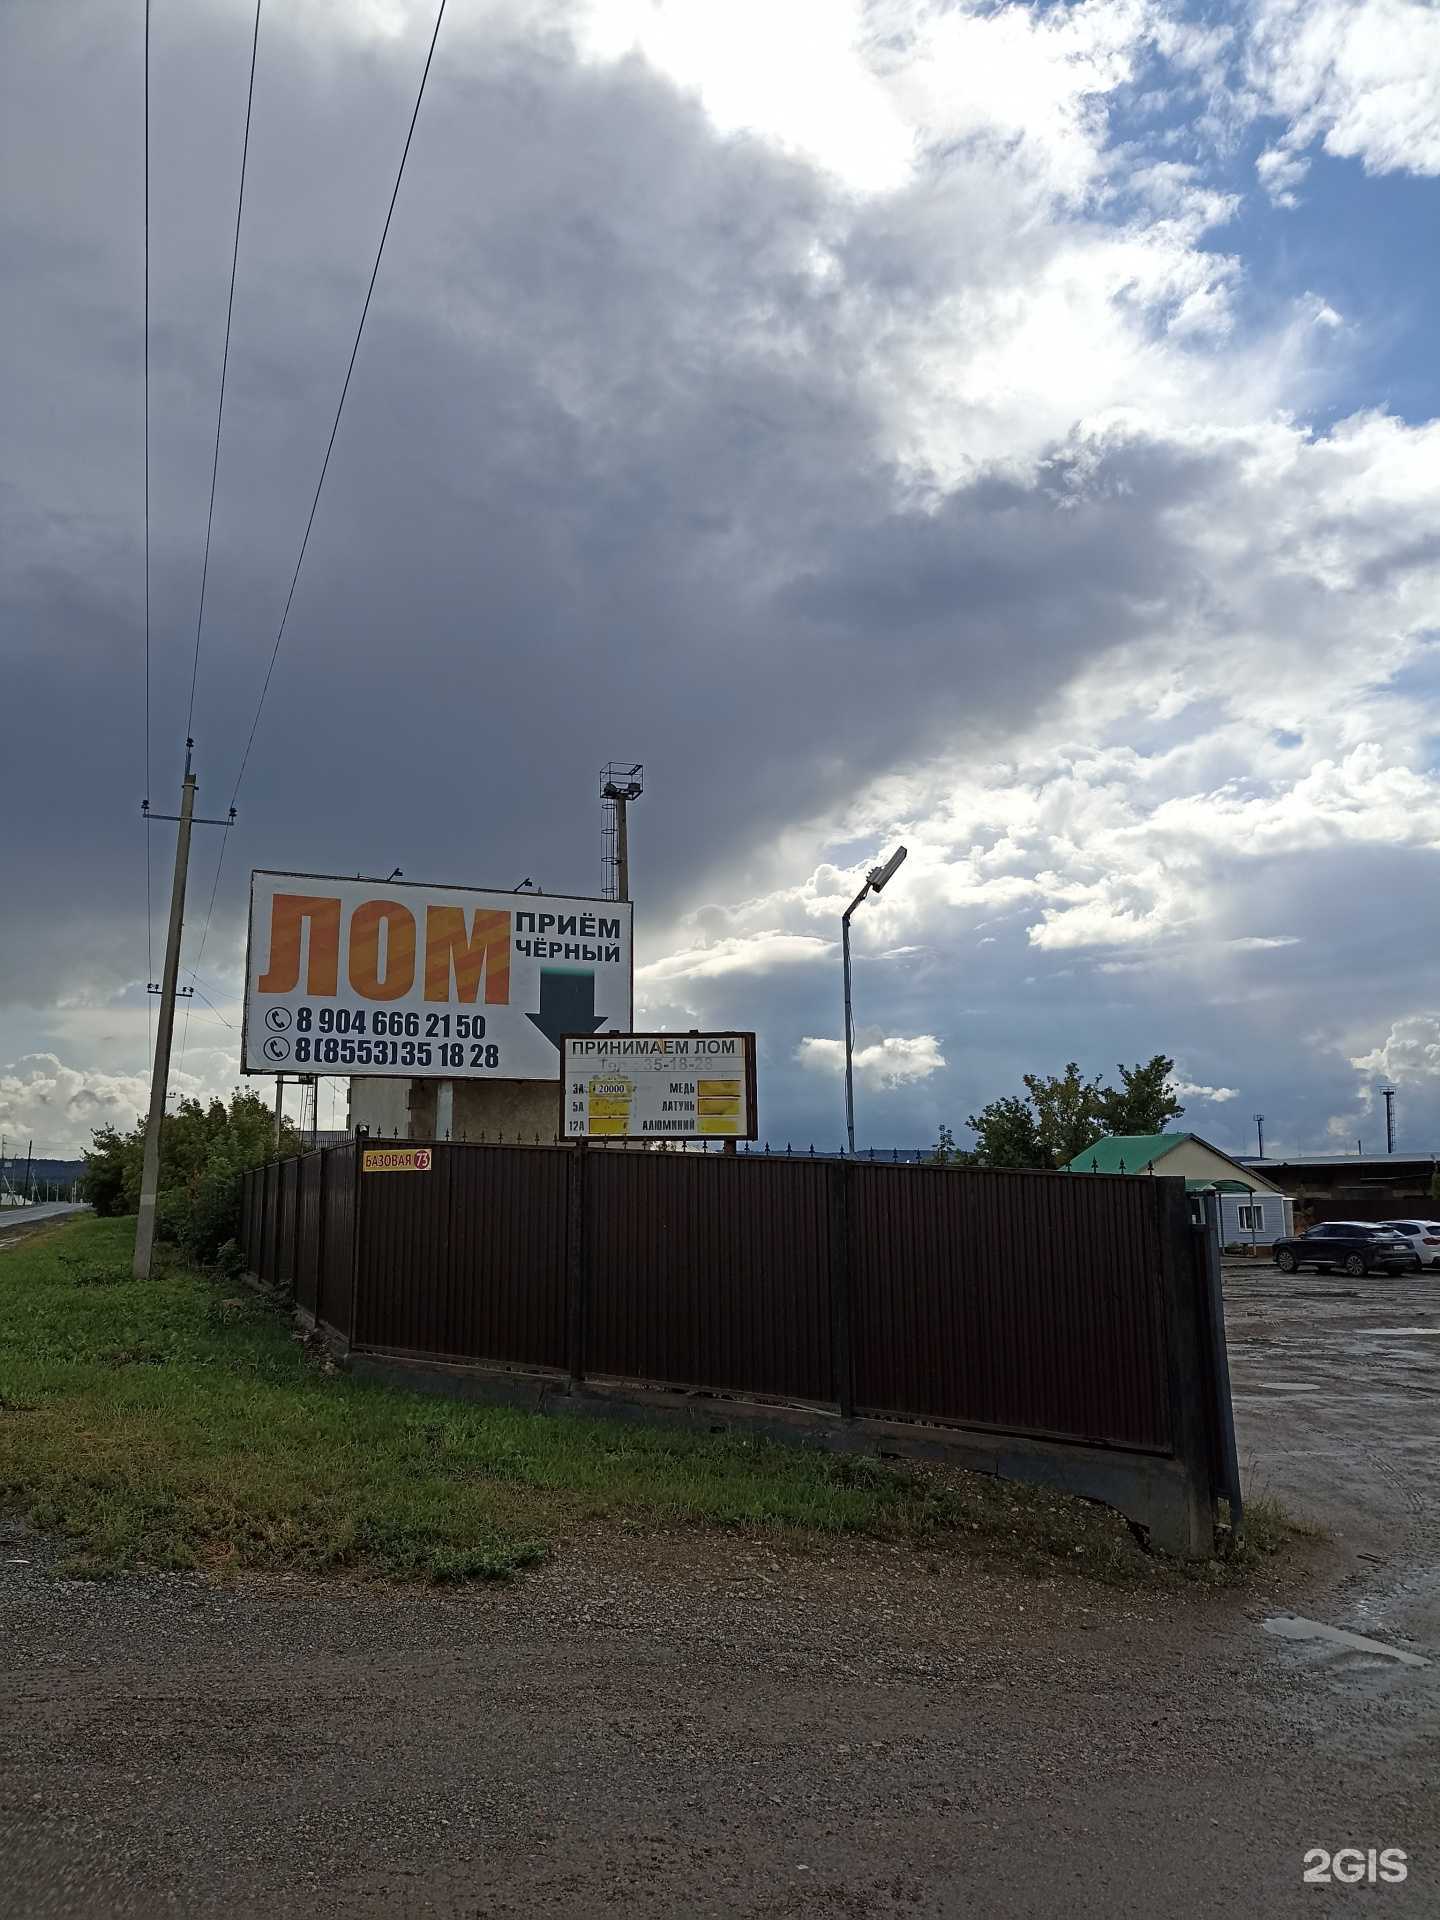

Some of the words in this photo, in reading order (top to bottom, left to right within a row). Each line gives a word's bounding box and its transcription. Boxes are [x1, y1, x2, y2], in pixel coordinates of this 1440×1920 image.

[515, 911, 621, 939] ПРИЁМ
[258, 893, 512, 1005] ЛОМ
[515, 938, 621, 963] ЧЁРНЫЙ
[296, 1007, 312, 1033] 8
[318, 1008, 366, 1035] 904
[372, 1011, 419, 1037] 666
[425, 1013, 450, 1038] 21
[456, 1015, 486, 1039] 50
[438, 1043, 464, 1067] 18
[470, 1044, 499, 1068] 28
[572, 1039, 689, 1055] ПРИНИМАЕМ
[694, 1039, 735, 1054] ЛОМ
[669, 1083, 695, 1095] МЕДЬ
[662, 1100, 695, 1112] ЛАТУНЬ
[642, 1118, 695, 1131] АЛЮМИНИЙ
[365, 1154, 411, 1167] БАЗОВАЯ
[416, 1153, 428, 1167] 73
